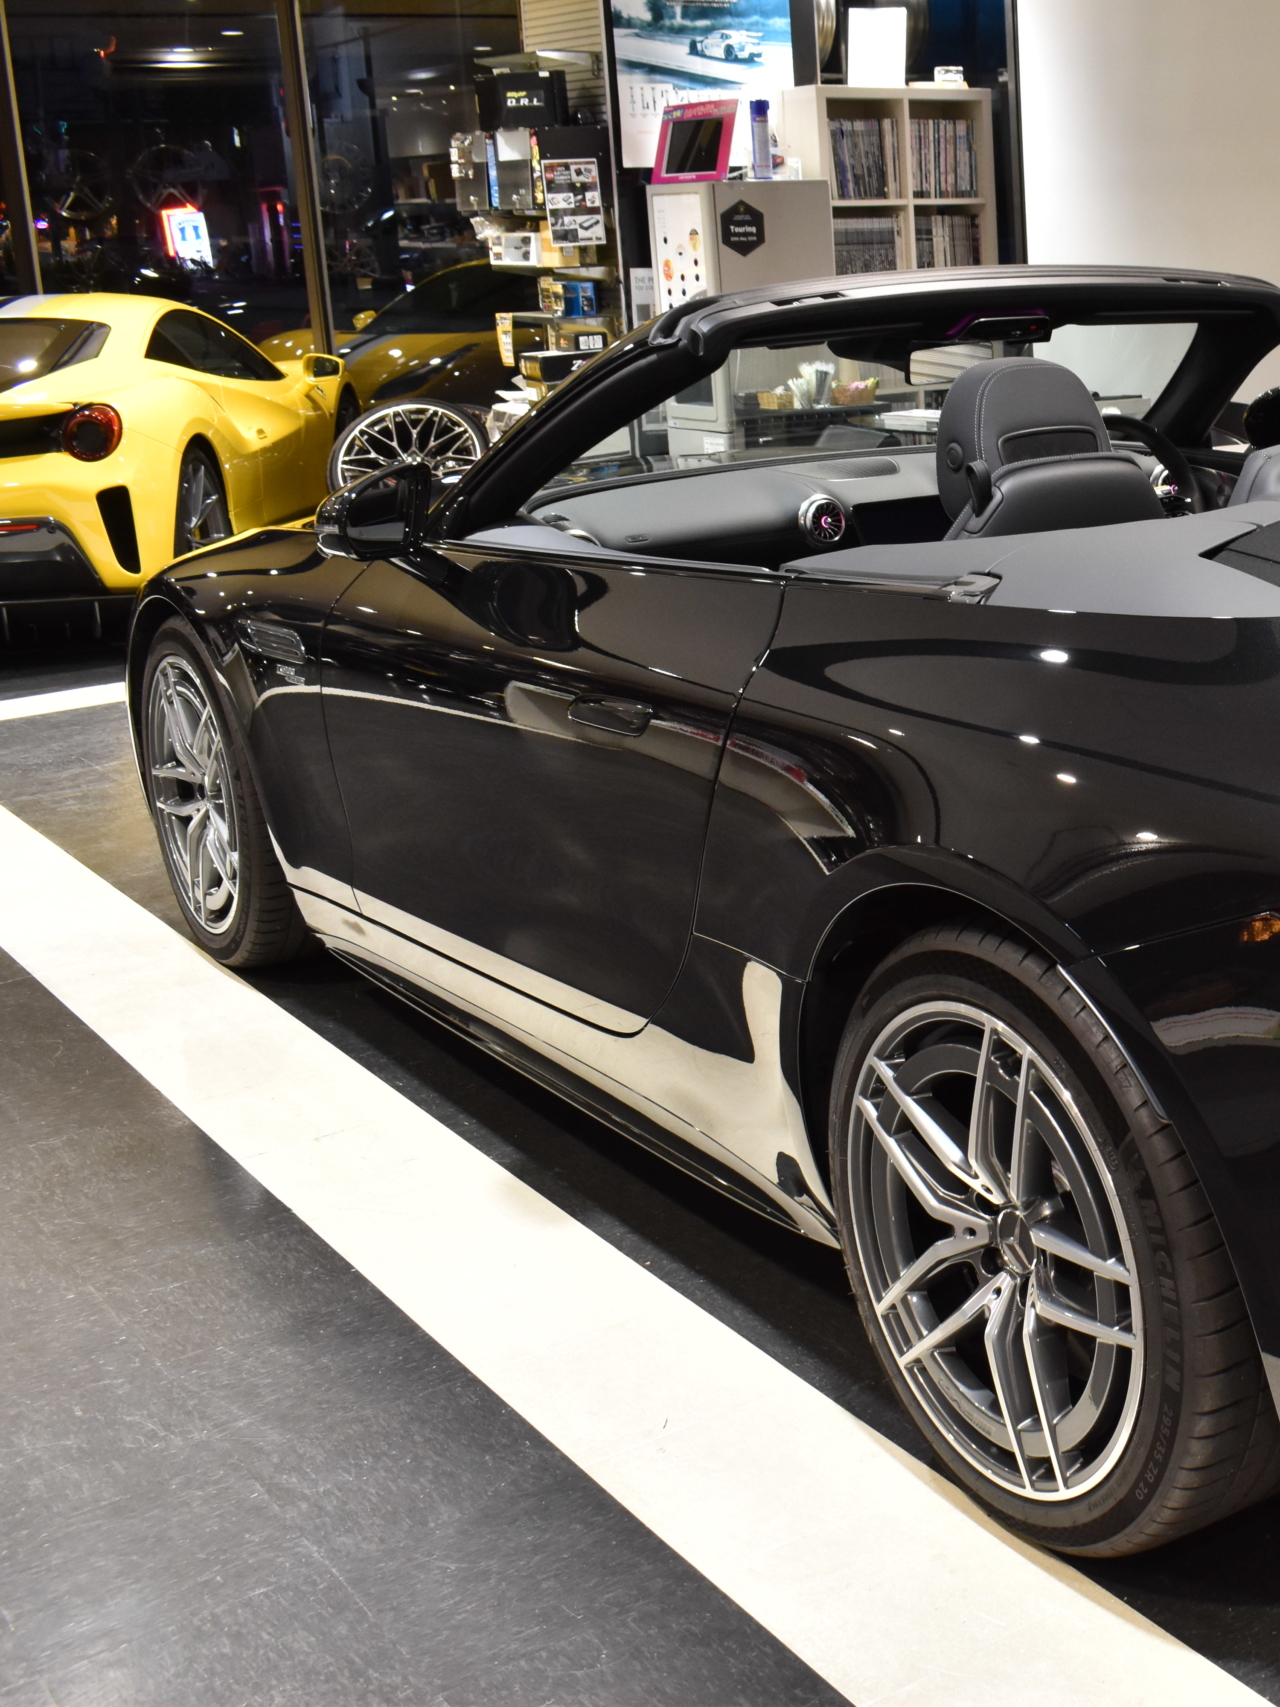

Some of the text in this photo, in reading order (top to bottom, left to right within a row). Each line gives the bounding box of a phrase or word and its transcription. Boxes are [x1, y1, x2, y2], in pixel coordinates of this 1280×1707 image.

[729, 225, 757, 234] Touring
[1135, 1199, 1183, 1500] MICHELIN 295/35 ZR 20
